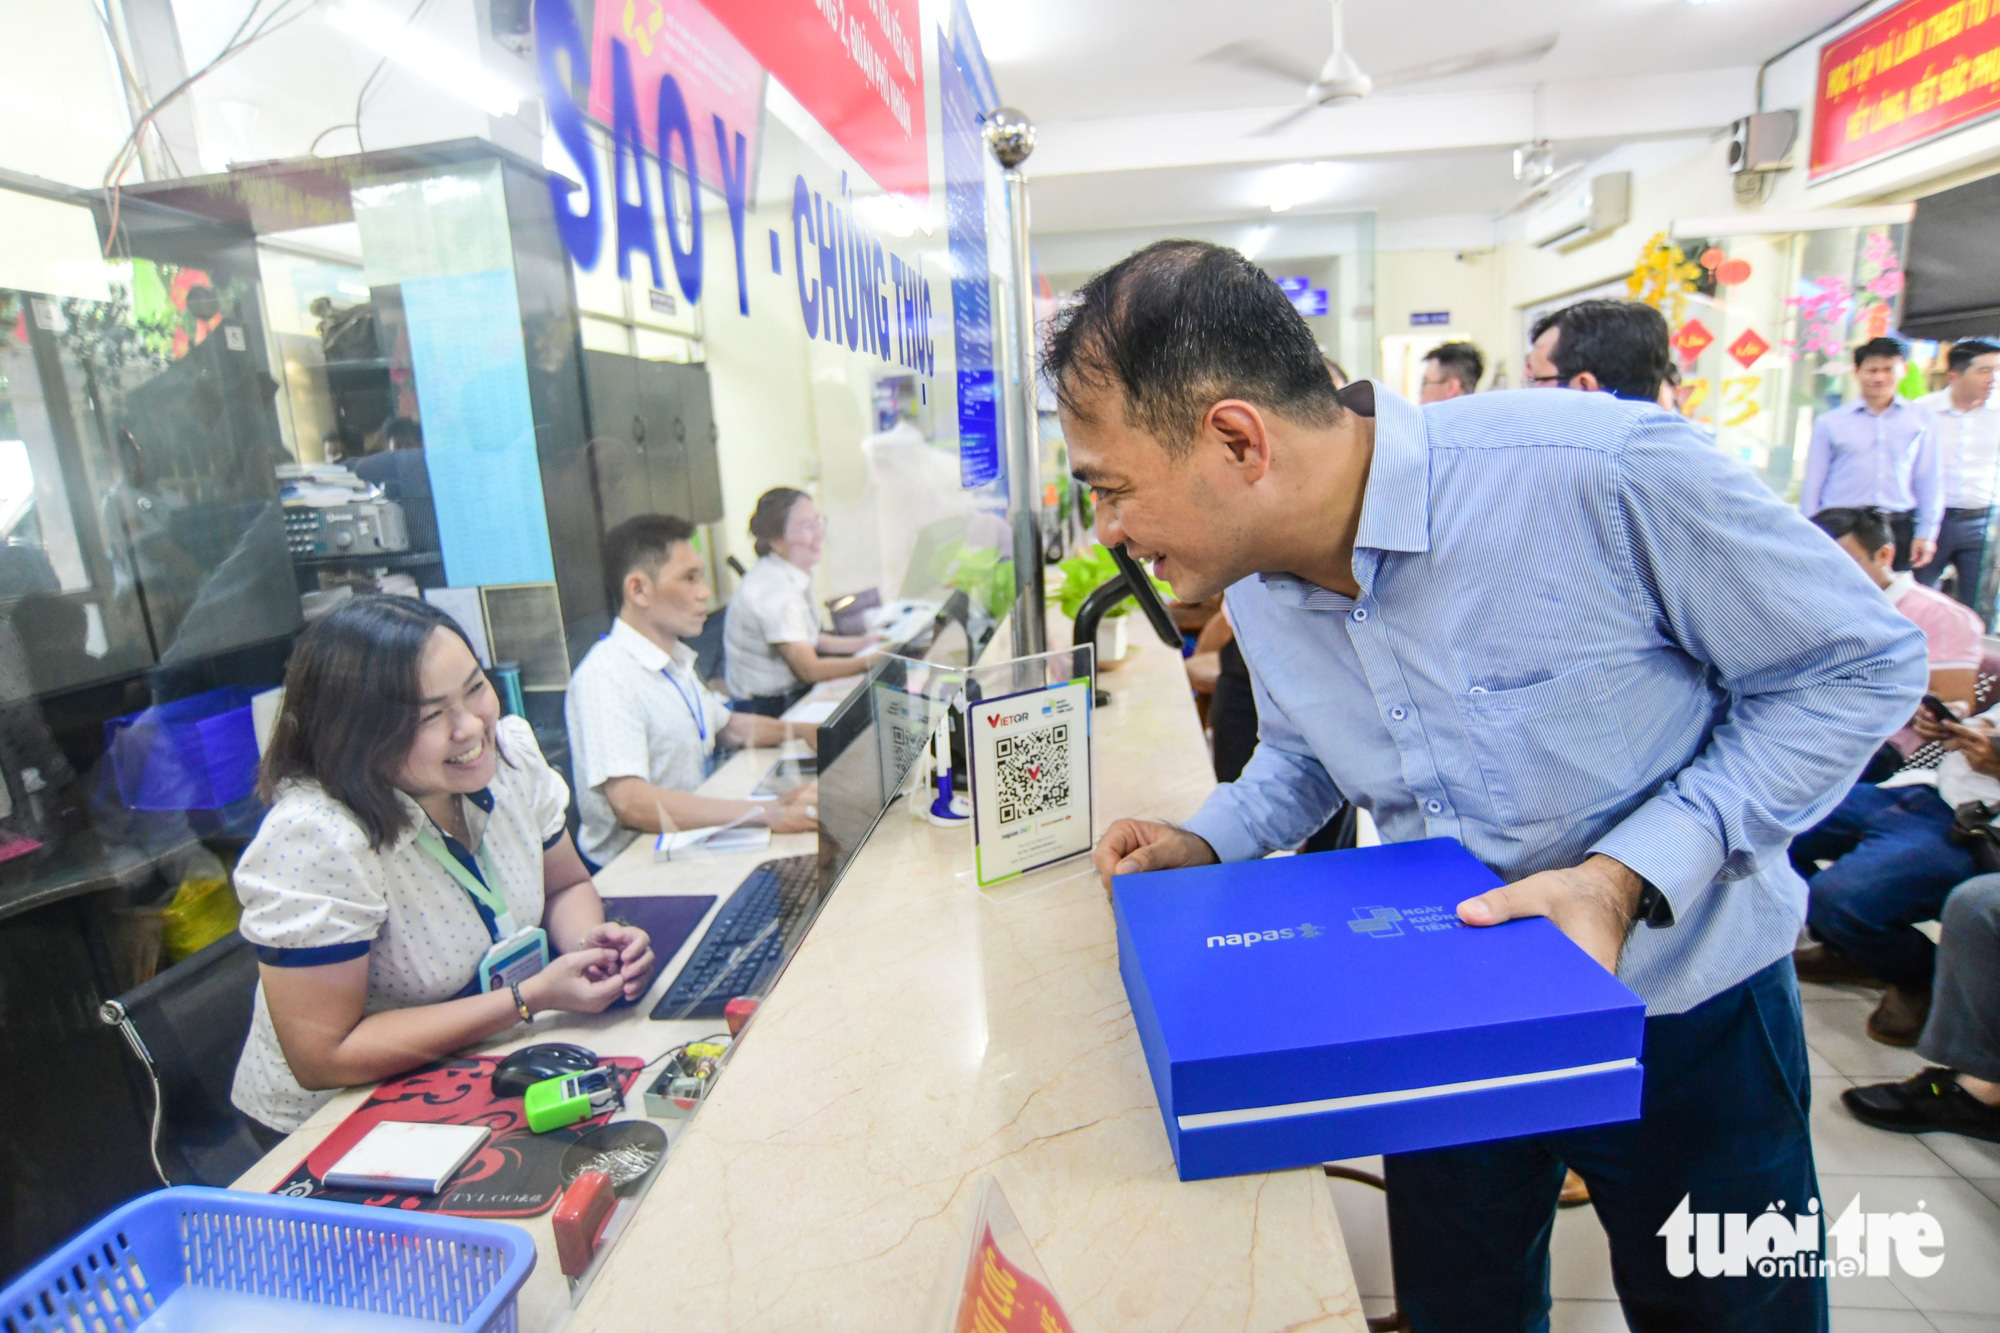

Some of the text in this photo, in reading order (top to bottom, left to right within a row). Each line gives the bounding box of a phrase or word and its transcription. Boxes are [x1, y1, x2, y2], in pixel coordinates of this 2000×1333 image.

[849, 15, 875, 90] QUẬN
[874, 51, 890, 107] PHÚ
[889, 75, 912, 143] NHUẬN
[533, 0, 704, 306] SAO
[711, 112, 750, 318] Y
[793, 168, 892, 363] CHỨNG
[890, 250, 934, 406] THỰC
[987, 712, 1030, 729] VIETQR
[1401, 905, 1443, 916] NGÀY
[1206, 926, 1295, 948] napas
